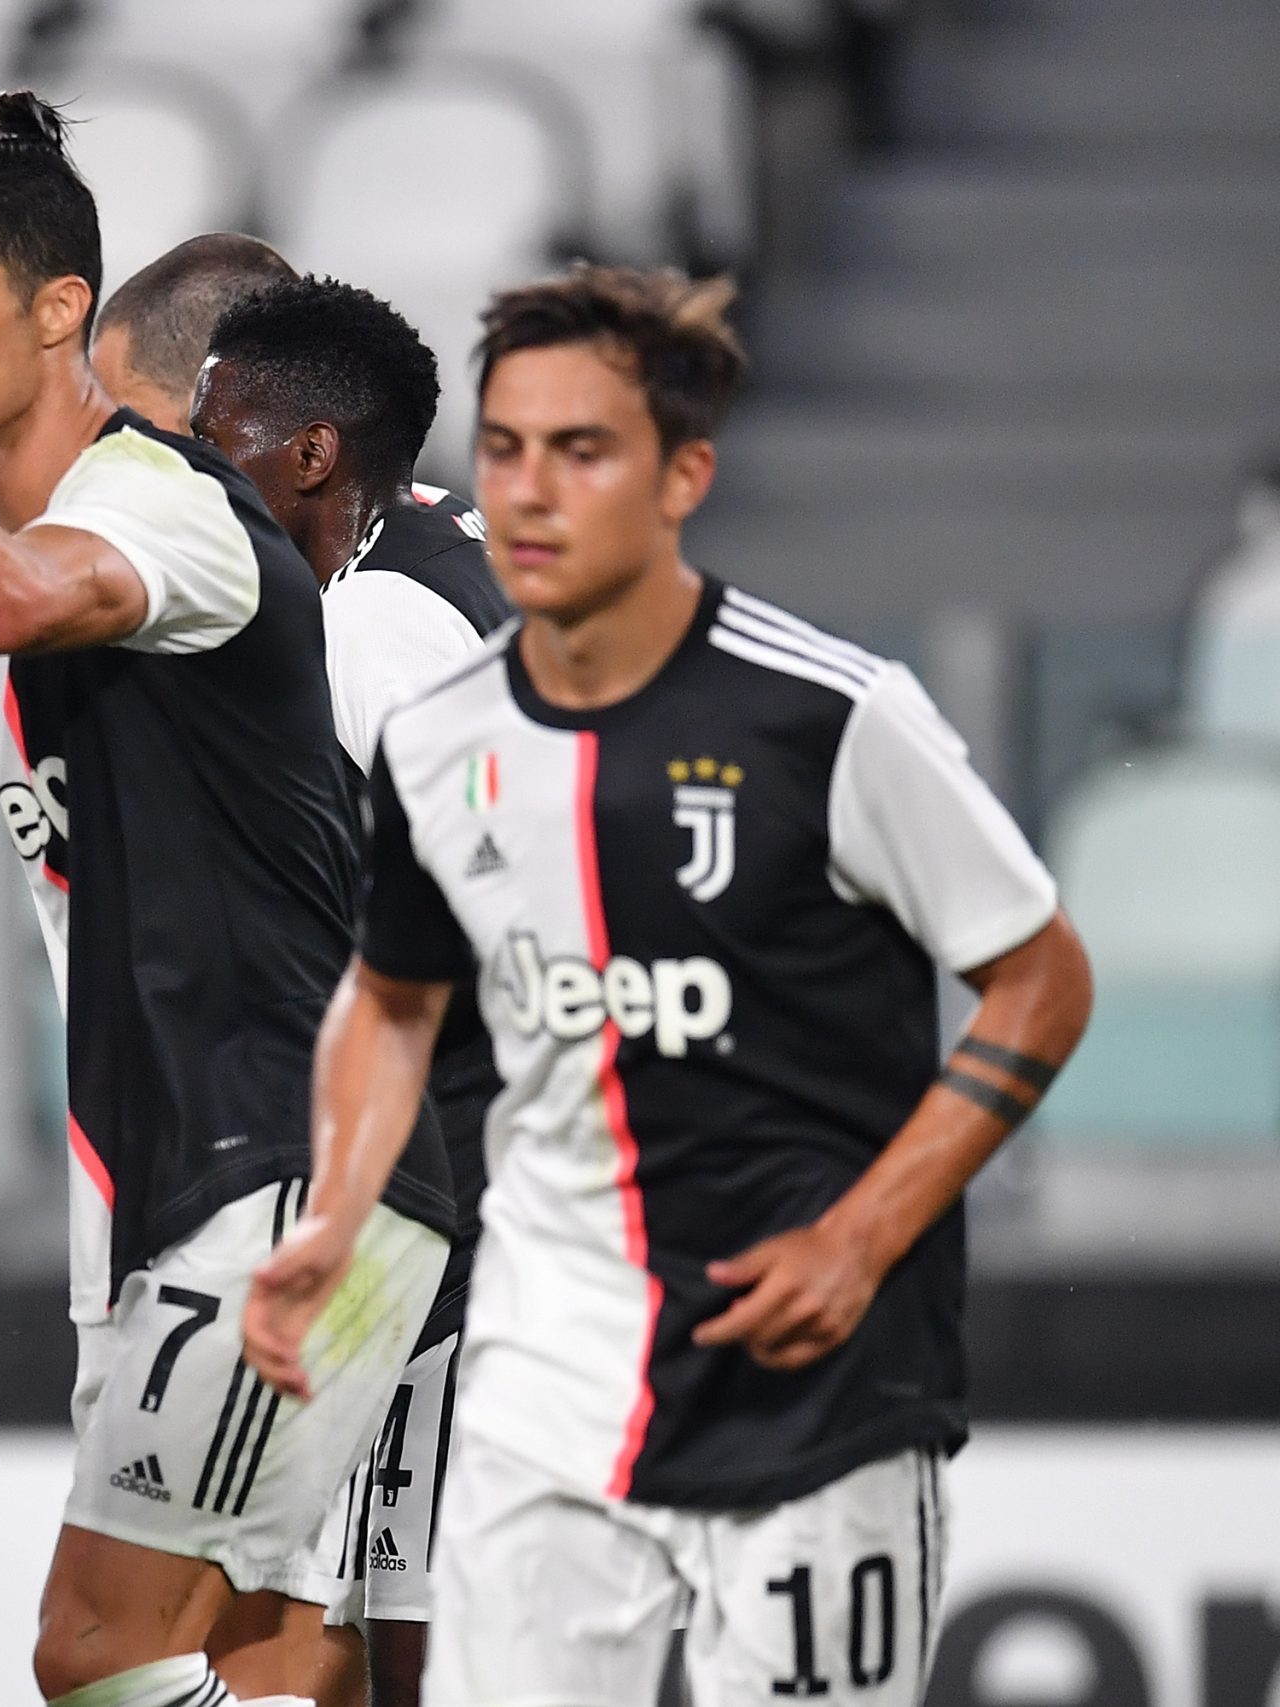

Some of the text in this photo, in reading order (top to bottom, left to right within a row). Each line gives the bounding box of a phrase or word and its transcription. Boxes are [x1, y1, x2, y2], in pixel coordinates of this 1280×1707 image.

[496, 930, 732, 1058] Jeep
[139, 1284, 222, 1414] 7
[110, 1473, 172, 1503] adidas
[766, 1553, 896, 1696] 10
